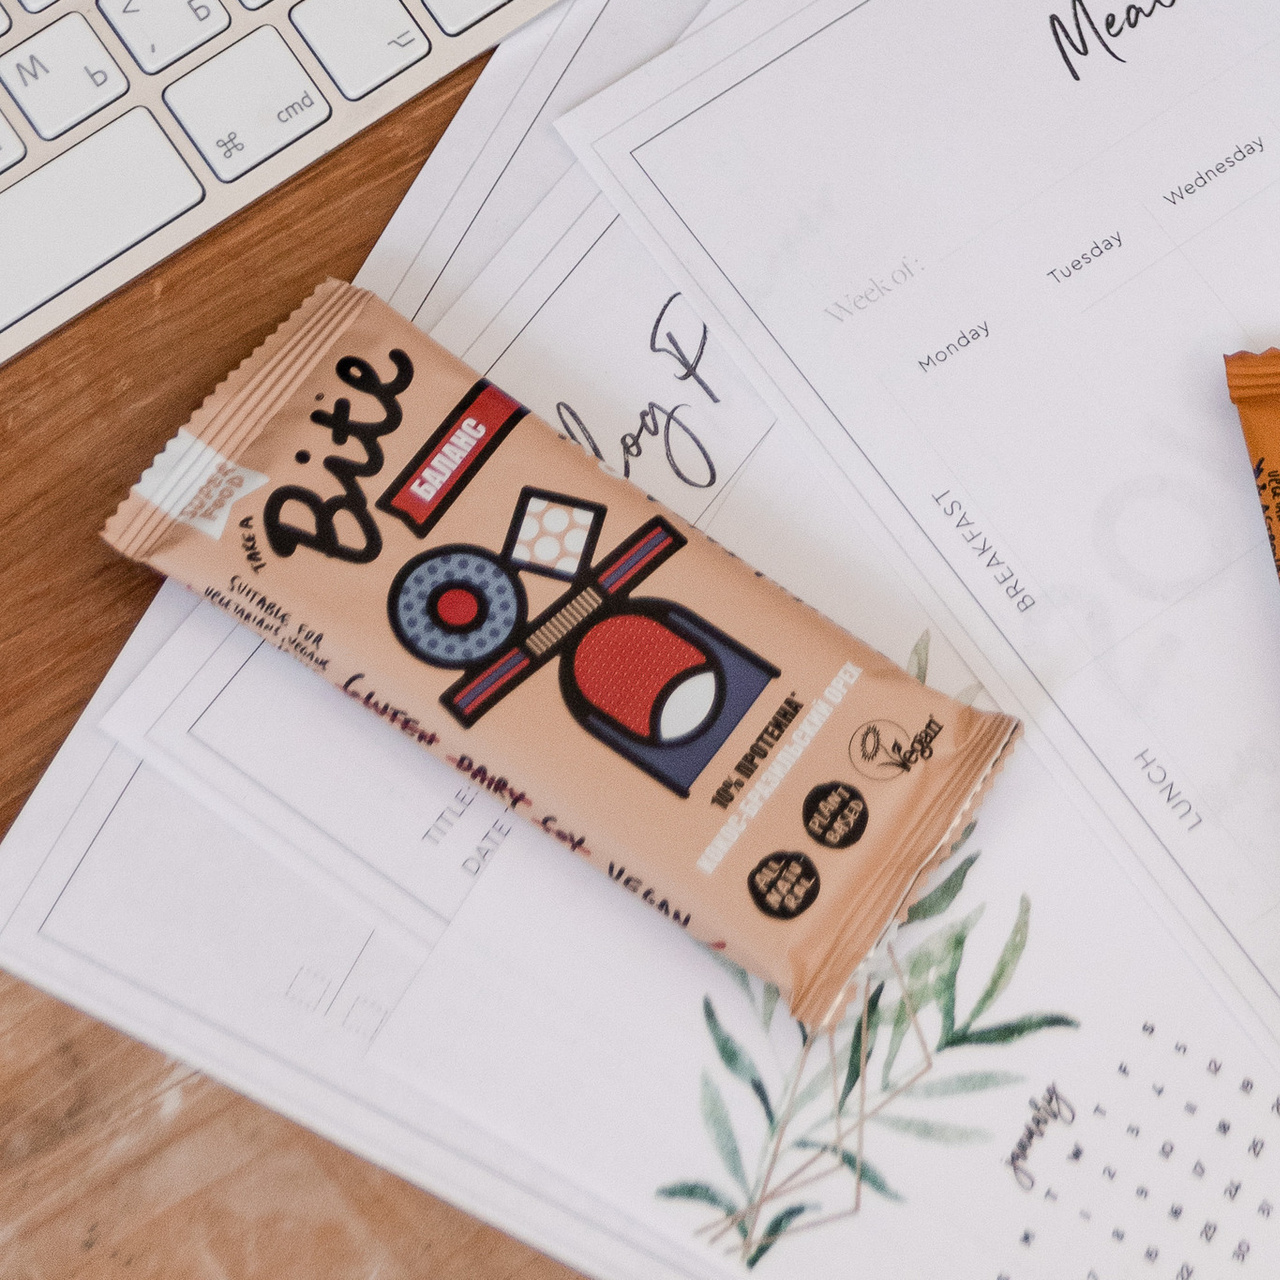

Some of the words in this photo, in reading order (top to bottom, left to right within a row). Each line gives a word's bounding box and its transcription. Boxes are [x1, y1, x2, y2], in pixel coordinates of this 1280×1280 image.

[276, 89, 316, 125] cmd
[917, 319, 991, 374] Monday
[1047, 230, 1124, 285] Tuesday
[1163, 134, 1266, 207] Wednesday
[263, 347, 415, 564] Bite
[409, 416, 489, 506] БАЛАНС
[239, 514, 254, 530] A
[932, 488, 1035, 613] BREAKFAST
[241, 531, 267, 573] TAKE
[229, 575, 292, 627] SUITABLE
[298, 624, 324, 650] FOR
[711, 775, 745, 810] 10%
[809, 785, 850, 836] PLANT
[1134, 748, 1202, 832] LUNCH
[825, 799, 864, 844] BASED
[607, 860, 692, 928] VEGAN
[755, 858, 787, 895] ALL
